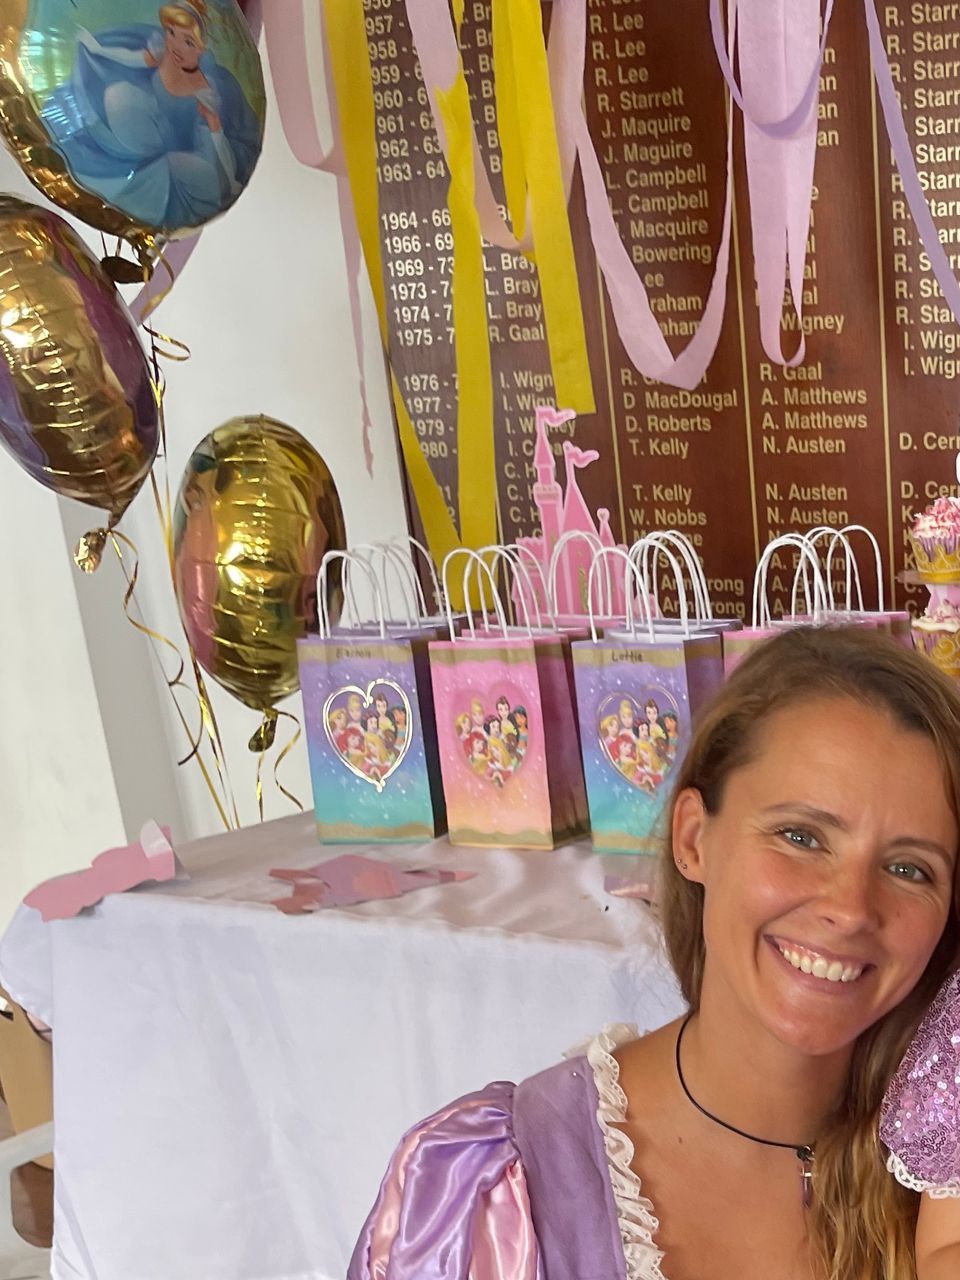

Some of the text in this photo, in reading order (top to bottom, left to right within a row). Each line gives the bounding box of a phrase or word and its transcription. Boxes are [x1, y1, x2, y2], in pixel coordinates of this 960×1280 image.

[366, 15, 392, 36] 957
[590, 12, 644, 34] R. Lee
[368, 40, 398, 60] 958
[592, 38, 646, 60] R. Lee
[886, 34, 906, 56] R.
[371, 64, 400, 85] 959
[595, 64, 649, 86] R. Lee
[374, 89, 403, 110] 960
[598, 87, 684, 112] R. Starrett
[376, 114, 405, 134] 961
[602, 119, 616, 138] J.
[604, 145, 619, 164] J.
[377, 163, 412, 183] 1963
[426, 160, 446, 180] 64
[606, 162, 707, 190] L. Campbell
[628, 189, 709, 216] Campbell
[892, 200, 911, 220] R.
[382, 212, 418, 231] 1964
[432, 208, 451, 227] 66
[630, 216, 708, 240] Macquire
[384, 235, 422, 254] 1966
[434, 233, 454, 251] 69
[893, 227, 912, 246] R.
[632, 242, 712, 264] Bowering
[894, 254, 912, 272] R.
[387, 258, 424, 278] 1969
[390, 282, 428, 301] 1973
[485, 278, 499, 296] L.
[504, 277, 539, 298] Bray
[895, 280, 913, 299] R.
[394, 305, 430, 324] 1974
[488, 302, 501, 320] L.
[506, 301, 542, 322] Bray
[650, 293, 702, 312] raham
[896, 306, 914, 325] R.
[397, 328, 433, 347] 1975
[490, 325, 505, 343] R.
[509, 324, 544, 342] Gaal
[403, 374, 439, 392] 1976
[513, 370, 552, 392] Wign
[620, 368, 638, 386] R.
[760, 362, 822, 382] R. Gaal
[406, 397, 441, 414] 1977
[645, 388, 738, 412] MacDougal
[761, 386, 868, 406] A. Matthews
[626, 414, 712, 433] D. Roberts
[762, 410, 868, 430] A. Matthews
[420, 442, 448, 458] 980
[628, 438, 690, 460] T. Kelly
[763, 435, 846, 454] N. Austen
[900, 433, 917, 450] D.
[632, 484, 692, 506] T. Kelly
[766, 483, 848, 500] N. Austen
[901, 481, 918, 499] D.
[628, 508, 708, 526] W. Nobbs
[767, 506, 849, 524] N. Austen
